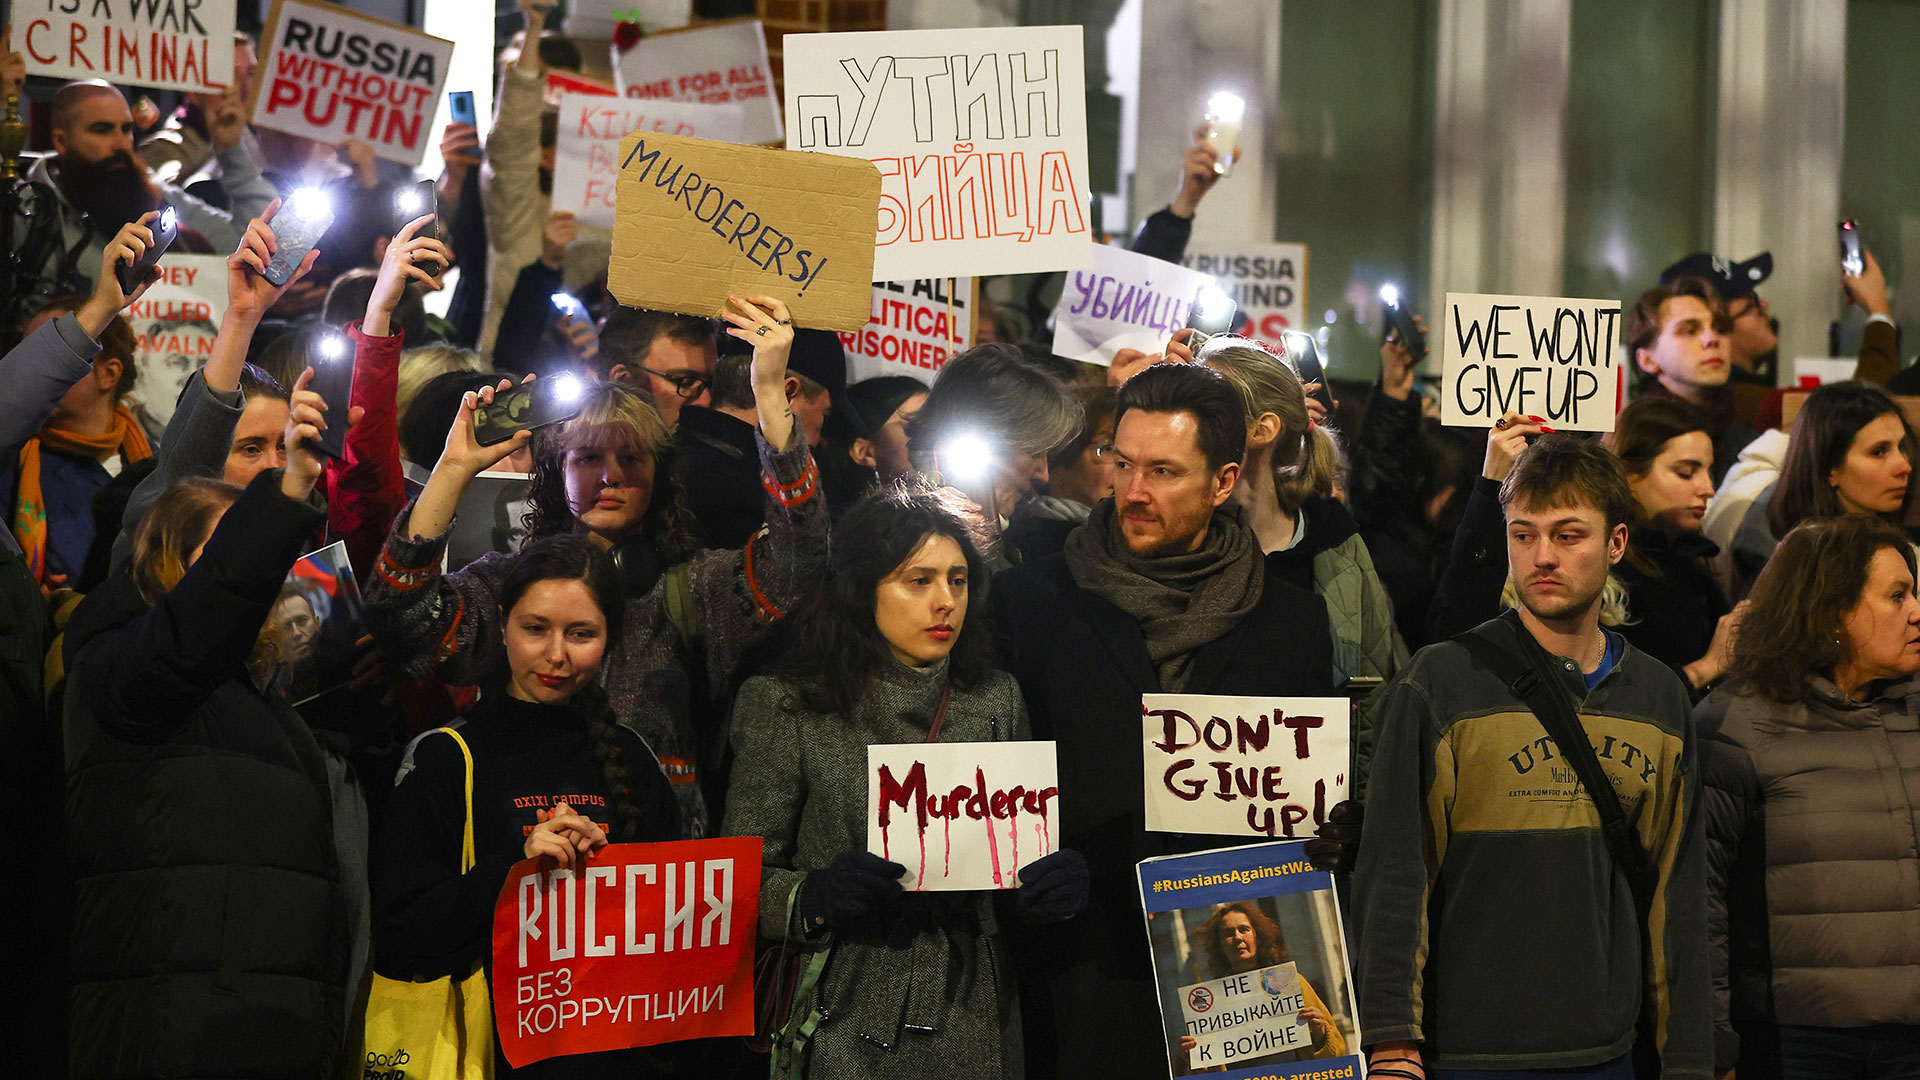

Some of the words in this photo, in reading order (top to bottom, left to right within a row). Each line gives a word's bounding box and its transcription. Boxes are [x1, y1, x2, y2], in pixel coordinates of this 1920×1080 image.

[26, 19, 228, 89] CRIMINAL
[283, 18, 435, 86] RUSSIA
[277, 50, 433, 112] WITHOUT
[626, 79, 674, 98] ONE
[678, 71, 721, 94] FOR
[728, 65, 766, 84] ALL
[266, 77, 424, 150] PUTIN
[871, 142, 1086, 246] БИЙЦА
[621, 139, 828, 298] MURDERERS!
[1197, 253, 1295, 279] RUSSIA
[129, 299, 211, 322] KILLED
[912, 278, 965, 309] ALL
[136, 333, 216, 355] AVALN
[839, 328, 948, 371] RISONER
[1453, 304, 1521, 362] WE
[1546, 366, 1599, 425] UP
[1163, 759, 1291, 802] GIVE
[1508, 735, 1657, 784] UTITY
[877, 760, 1060, 838] Murderer
[1509, 790, 1532, 798] EXTRA
[1152, 860, 1316, 893] #RussiansAgainstWa
[518, 858, 734, 968] РОССИЯ
[517, 967, 573, 1005] БЕЗ
[1223, 975, 1251, 998] НЕ
[518, 984, 724, 1039] КОРРУПЦИИ
[1186, 993, 1305, 1036] ПРИВЫКАЙТЕ
[1200, 1044, 1213, 1062] К
[1223, 1025, 1298, 1059] ВОЙНЕ
[1290, 1065, 1354, 1080] arrested
